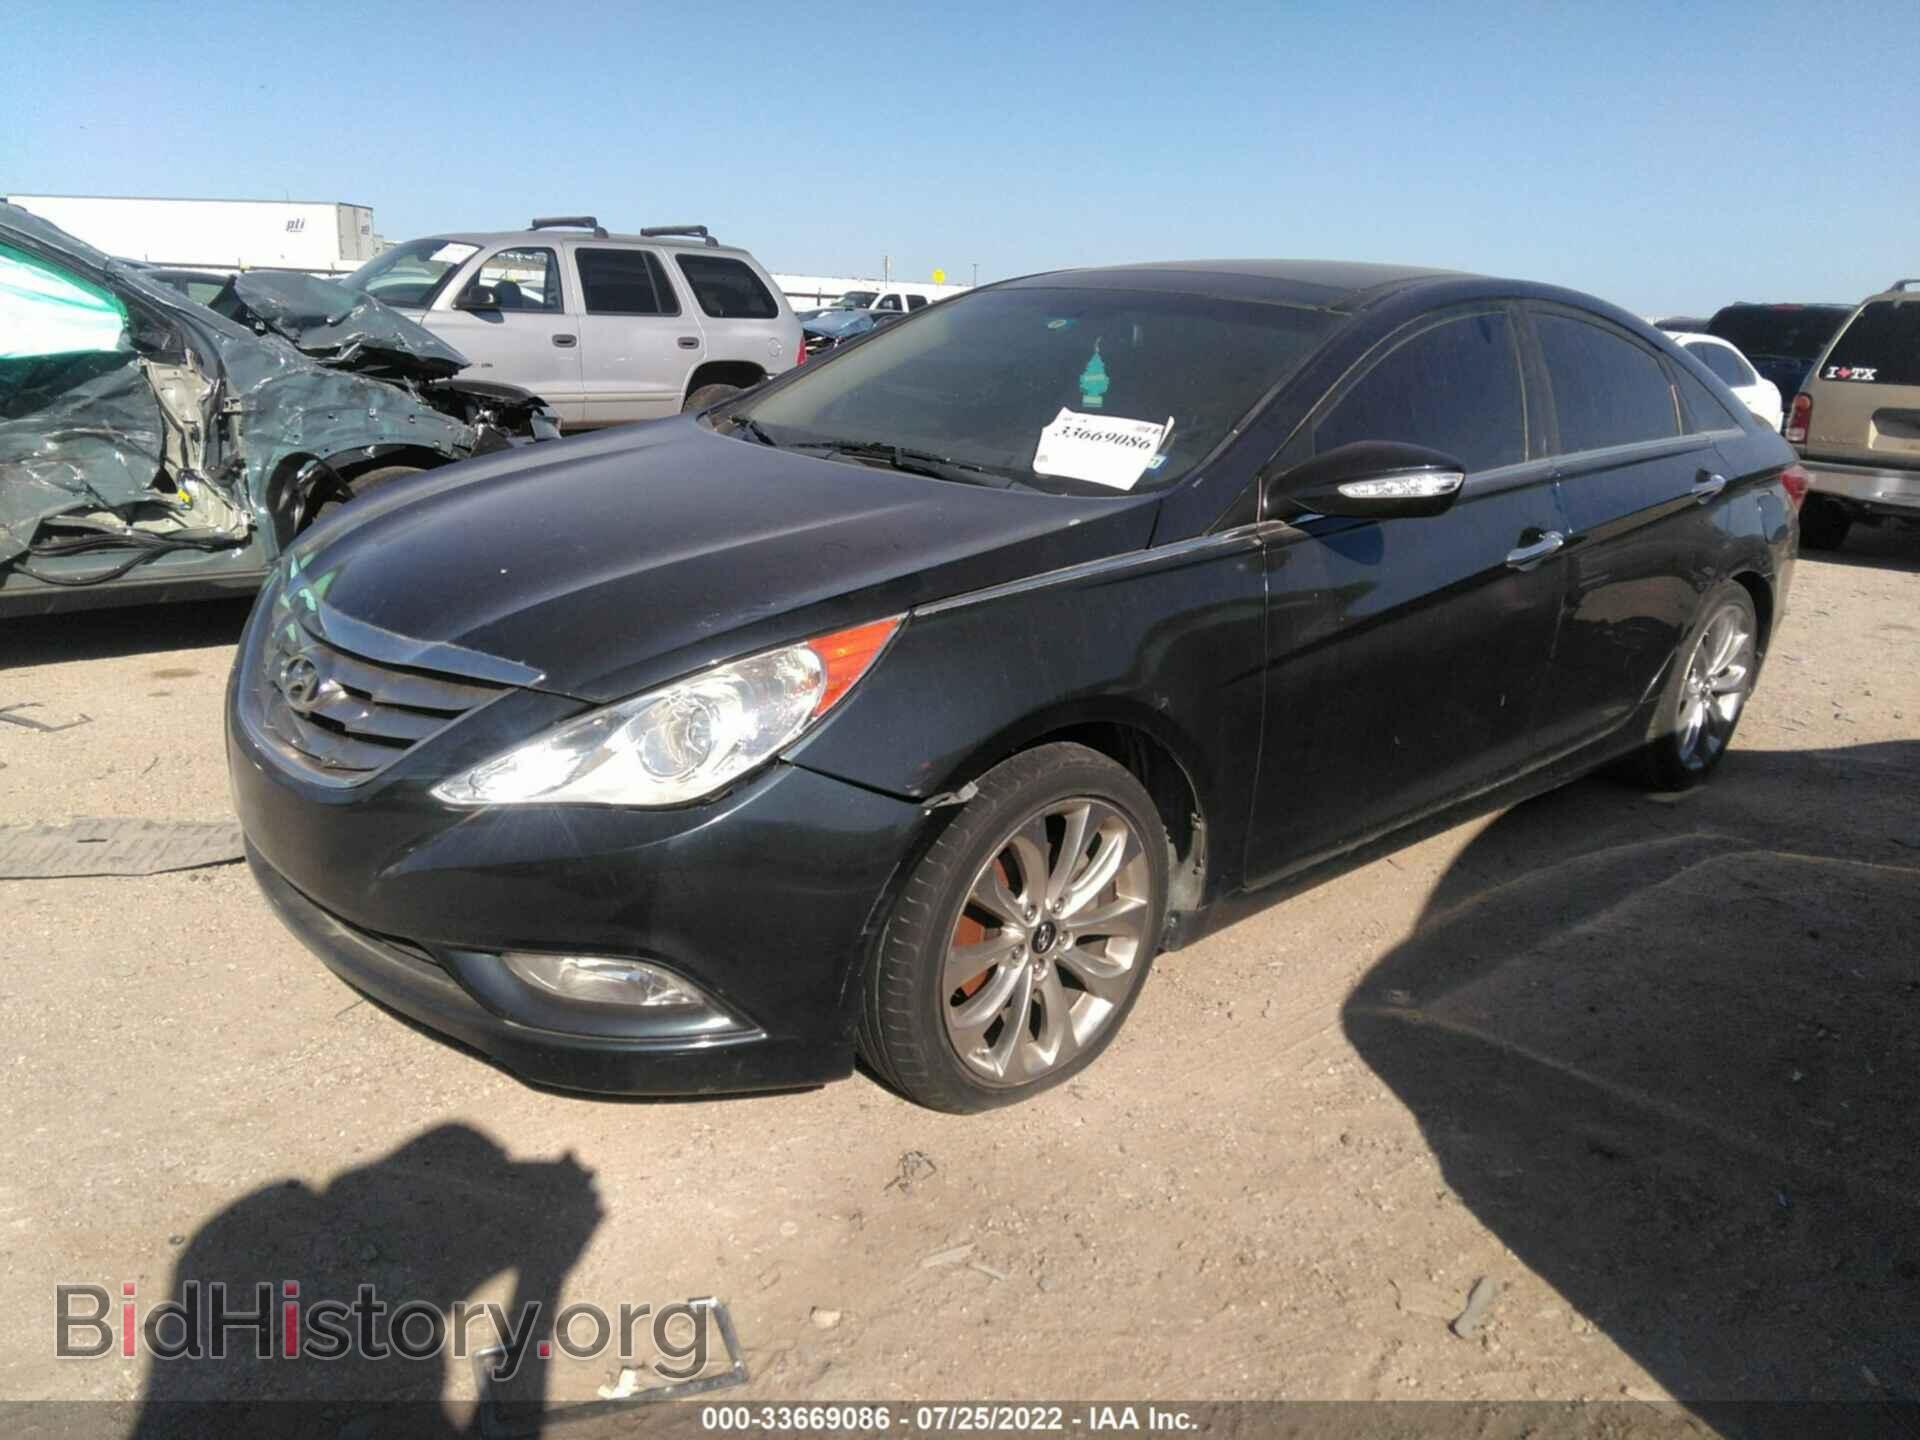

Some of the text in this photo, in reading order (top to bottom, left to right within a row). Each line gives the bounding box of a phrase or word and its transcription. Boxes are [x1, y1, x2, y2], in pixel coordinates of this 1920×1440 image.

[1826, 366, 1878, 380] I TX
[1054, 425, 1152, 449] 33669086
